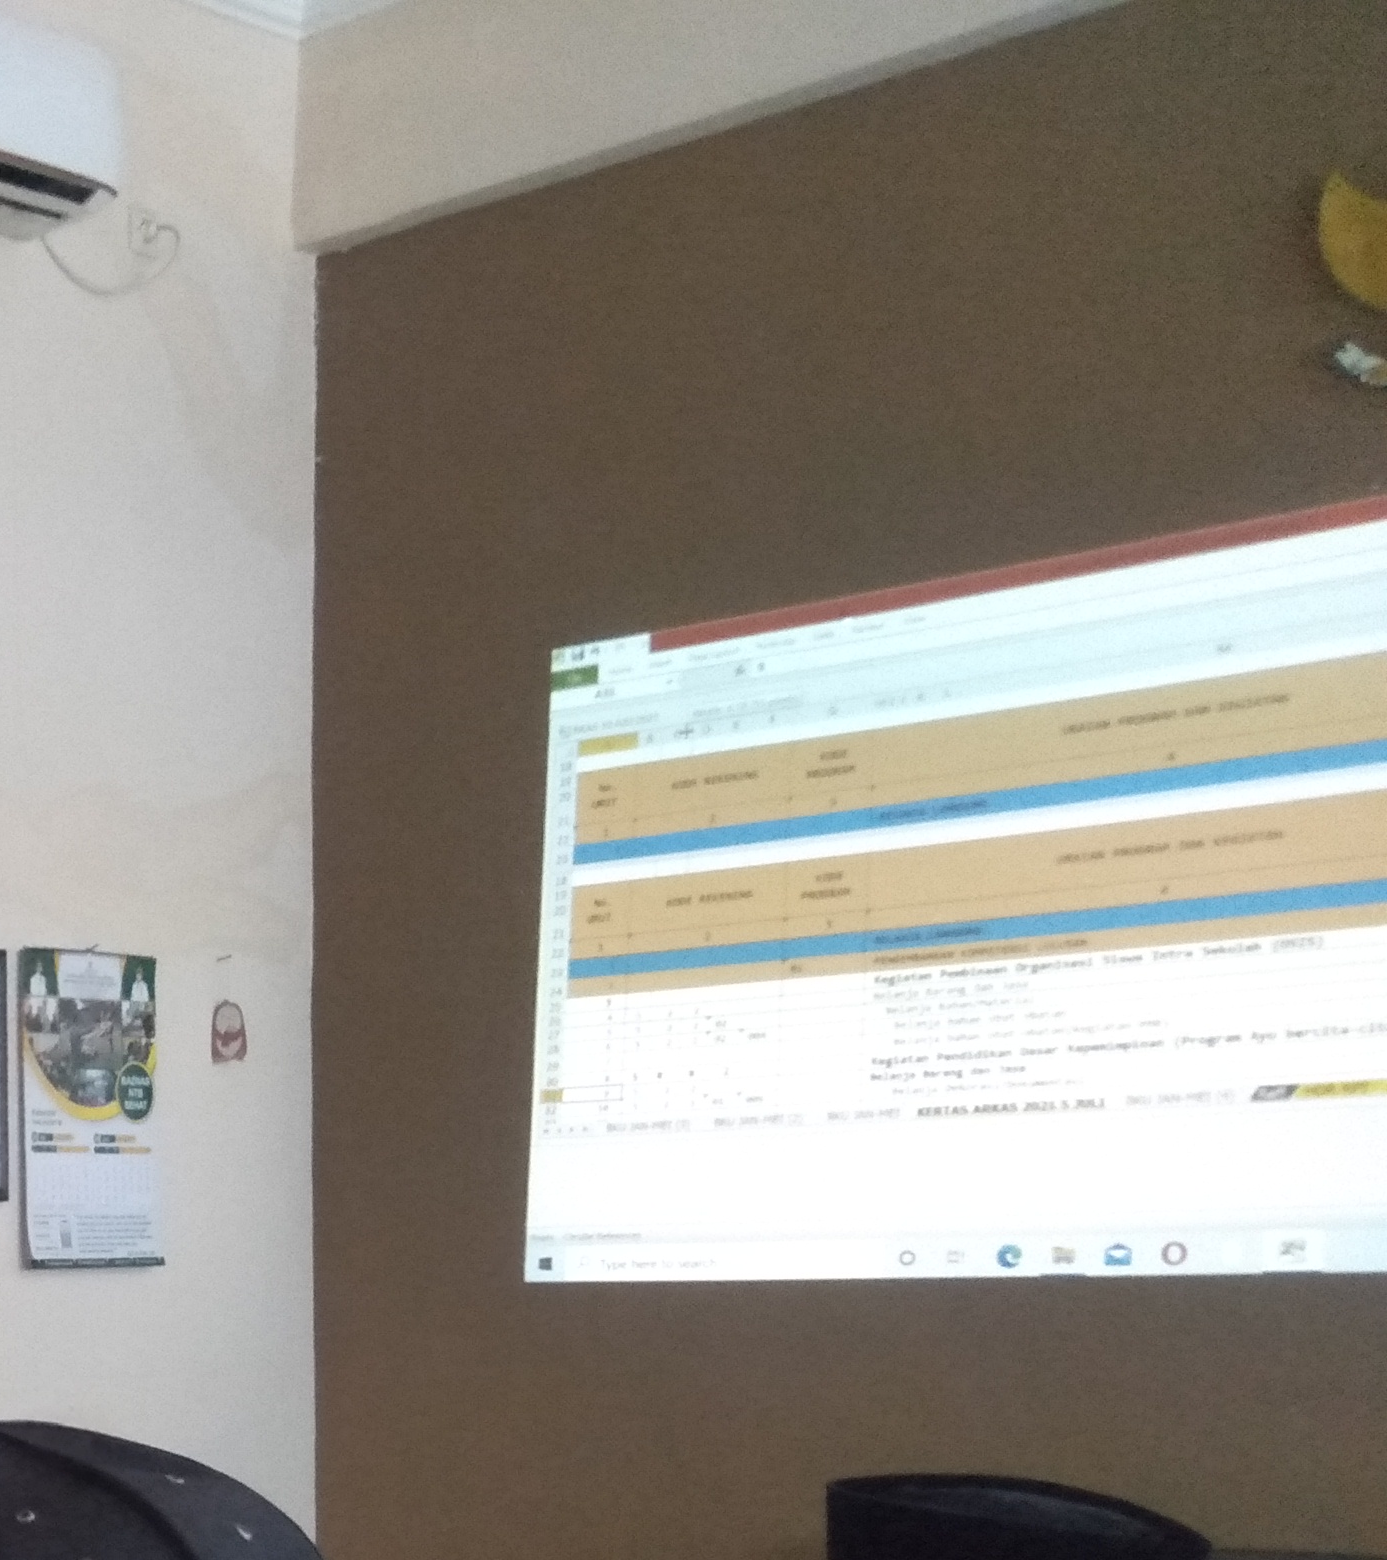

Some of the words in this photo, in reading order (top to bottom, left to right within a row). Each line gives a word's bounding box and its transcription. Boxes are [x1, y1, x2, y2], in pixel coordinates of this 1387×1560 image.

[601, 1259, 627, 1271] Type
[632, 1259, 657, 1268] here
[678, 1259, 717, 1268] search
